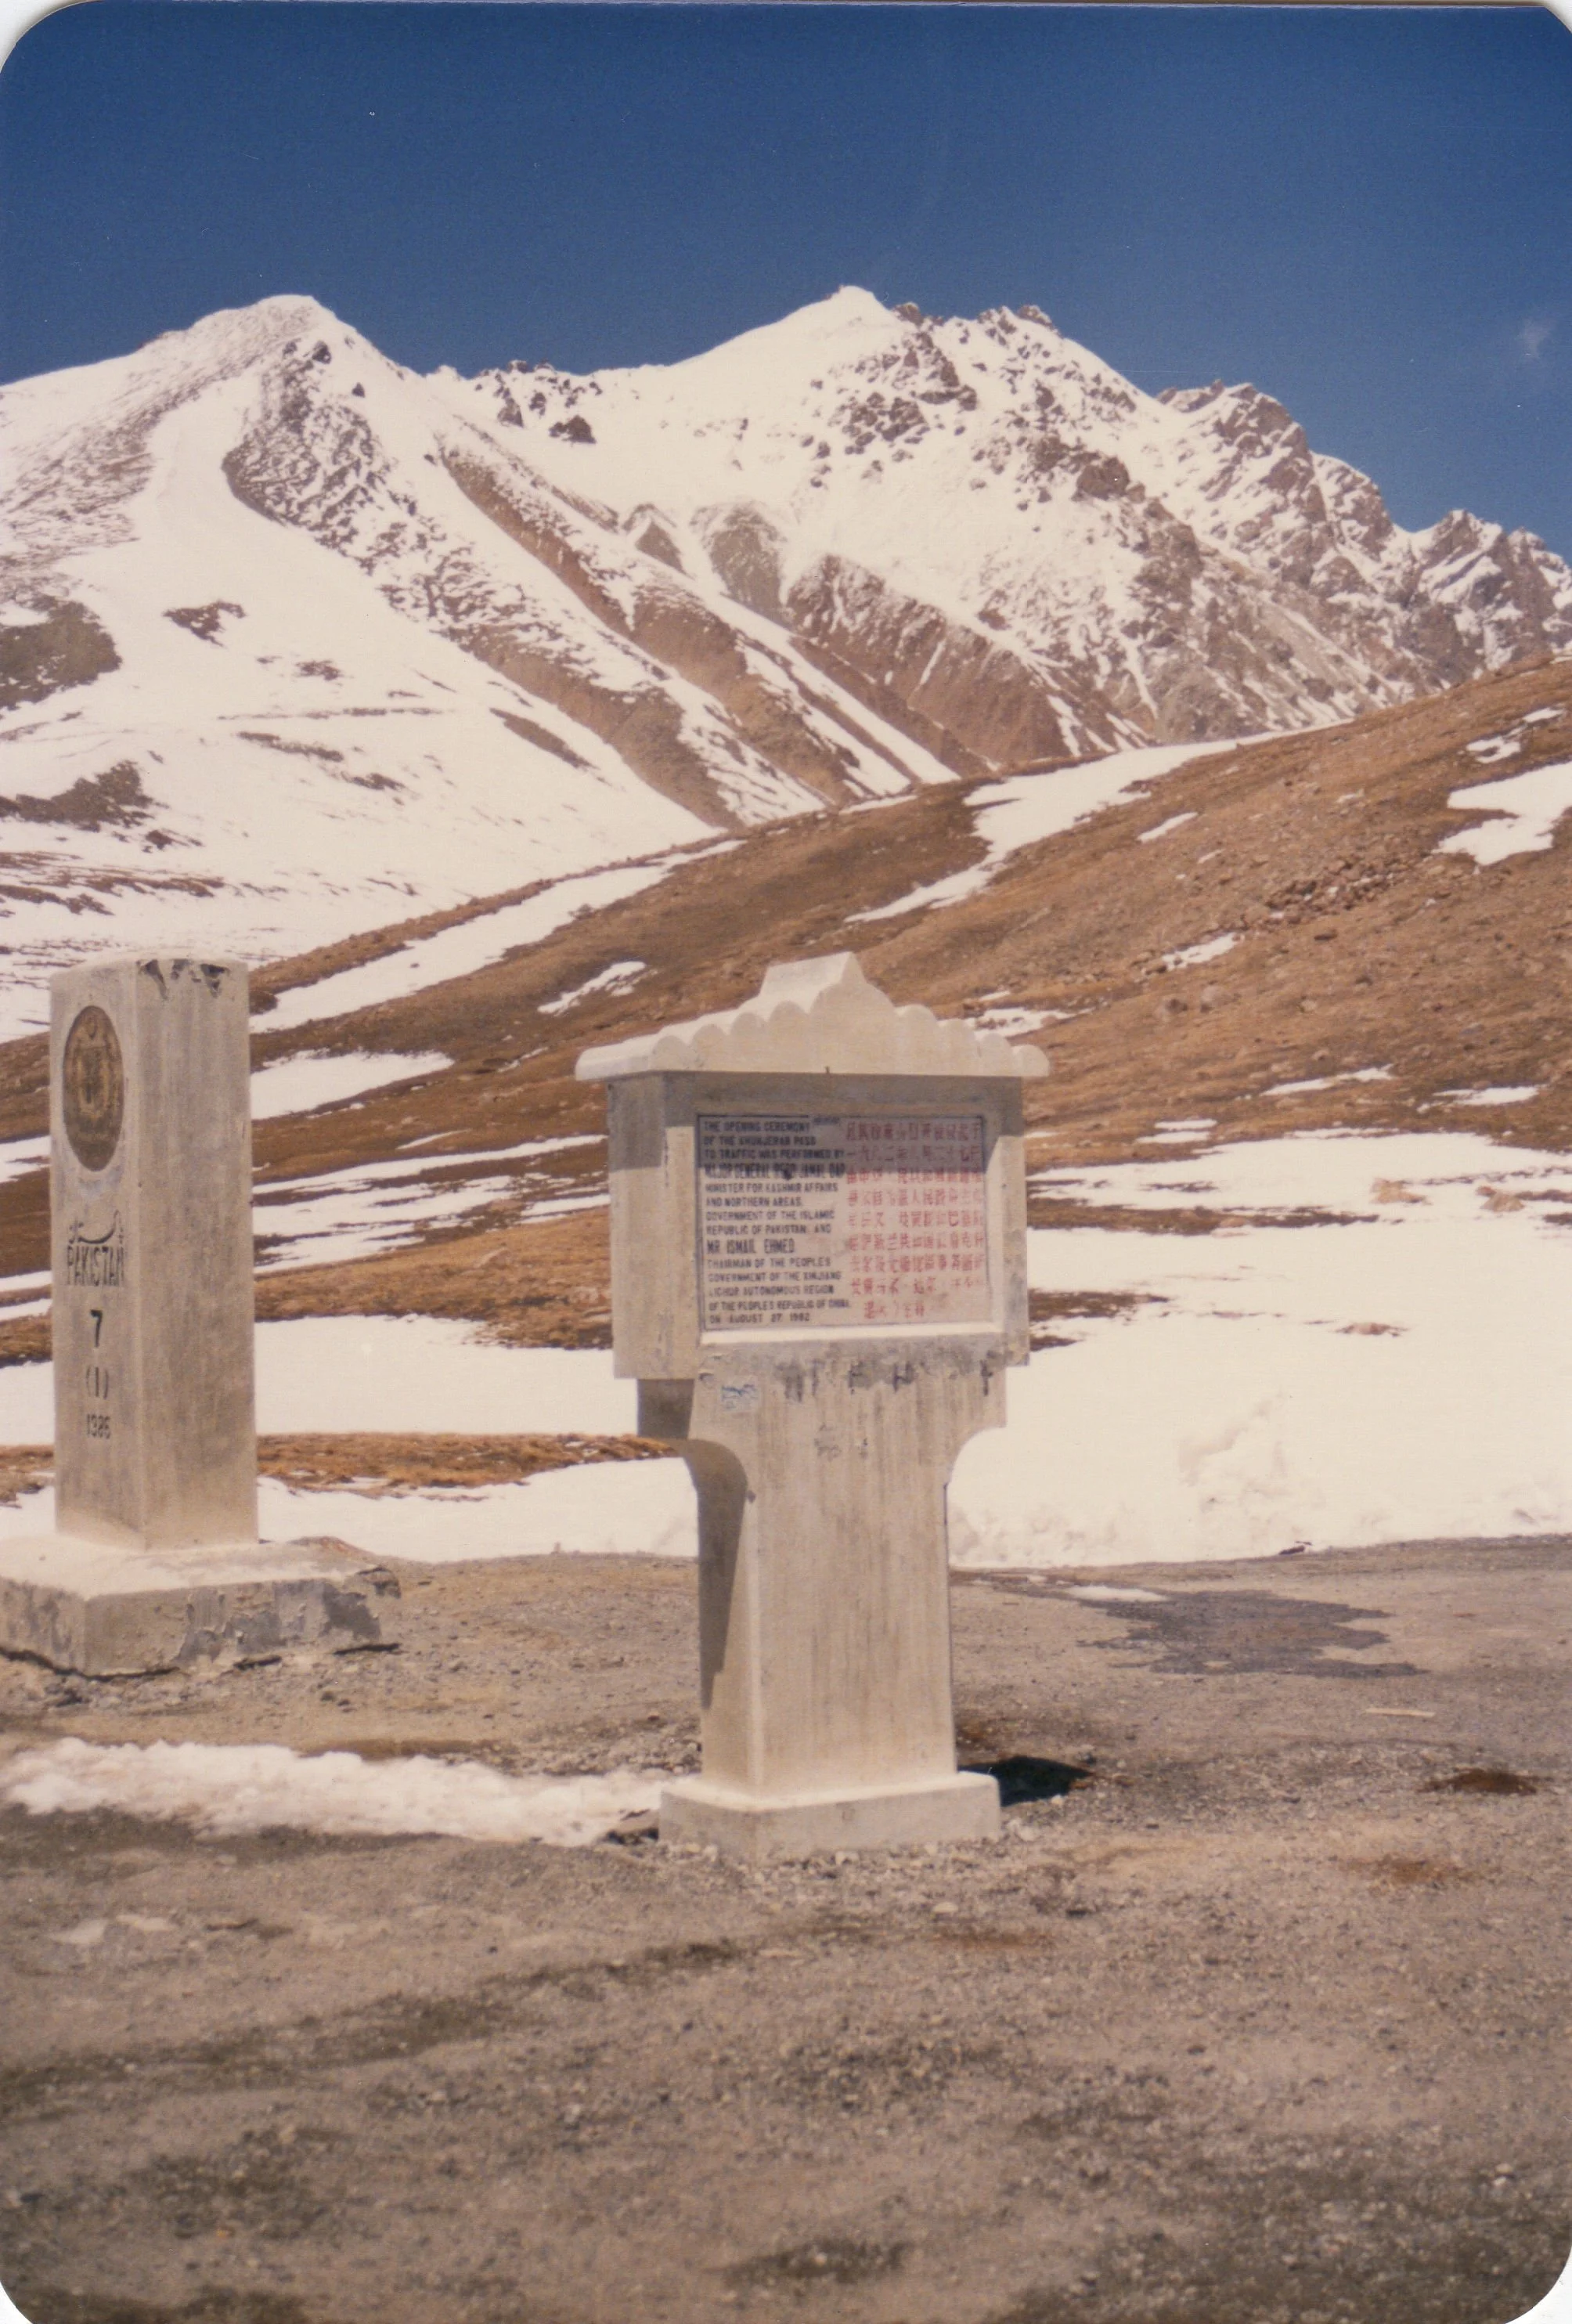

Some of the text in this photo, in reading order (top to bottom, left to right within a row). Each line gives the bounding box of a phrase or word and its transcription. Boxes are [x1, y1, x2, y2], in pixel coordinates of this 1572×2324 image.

[704, 1120, 719, 1132] THE
[723, 1120, 760, 1132] OPENING
[763, 1120, 809, 1133] CEREMONY
[704, 1135, 715, 1146] OF
[719, 1135, 734, 1146] THE
[705, 1149, 845, 1159] TO TRAFFIC WAS PERFORMED BY
[706, 1182, 838, 1193] MINISTER FOR KASHMIR AFFAIRS
[707, 1196, 722, 1207] AND
[725, 1196, 770, 1207] NORTHERN
[706, 1210, 835, 1221] GOVERNMENT OF THE ISLAMIC
[706, 1224, 749, 1236] REPUBLIC
[752, 1224, 763, 1235] OF
[67, 1246, 124, 1286] PAKISTAN
[708, 1258, 752, 1268] CHAIRMAN
[755, 1258, 765, 1268] OF
[770, 1258, 785, 1267] THE
[708, 1273, 766, 1283] GOVERNMENT
[770, 1273, 780, 1282] OF
[783, 1272, 800, 1282] THE
[743, 1286, 800, 1296] AUTONOMOUS
[803, 1285, 834, 1294] REGION
[709, 1301, 719, 1311] OF
[721, 1301, 735, 1311] THE
[709, 1315, 720, 1324] ON
[729, 1313, 763, 1323] AUGUST
[790, 1312, 810, 1322] 1982
[90, 1309, 103, 1348] 7
